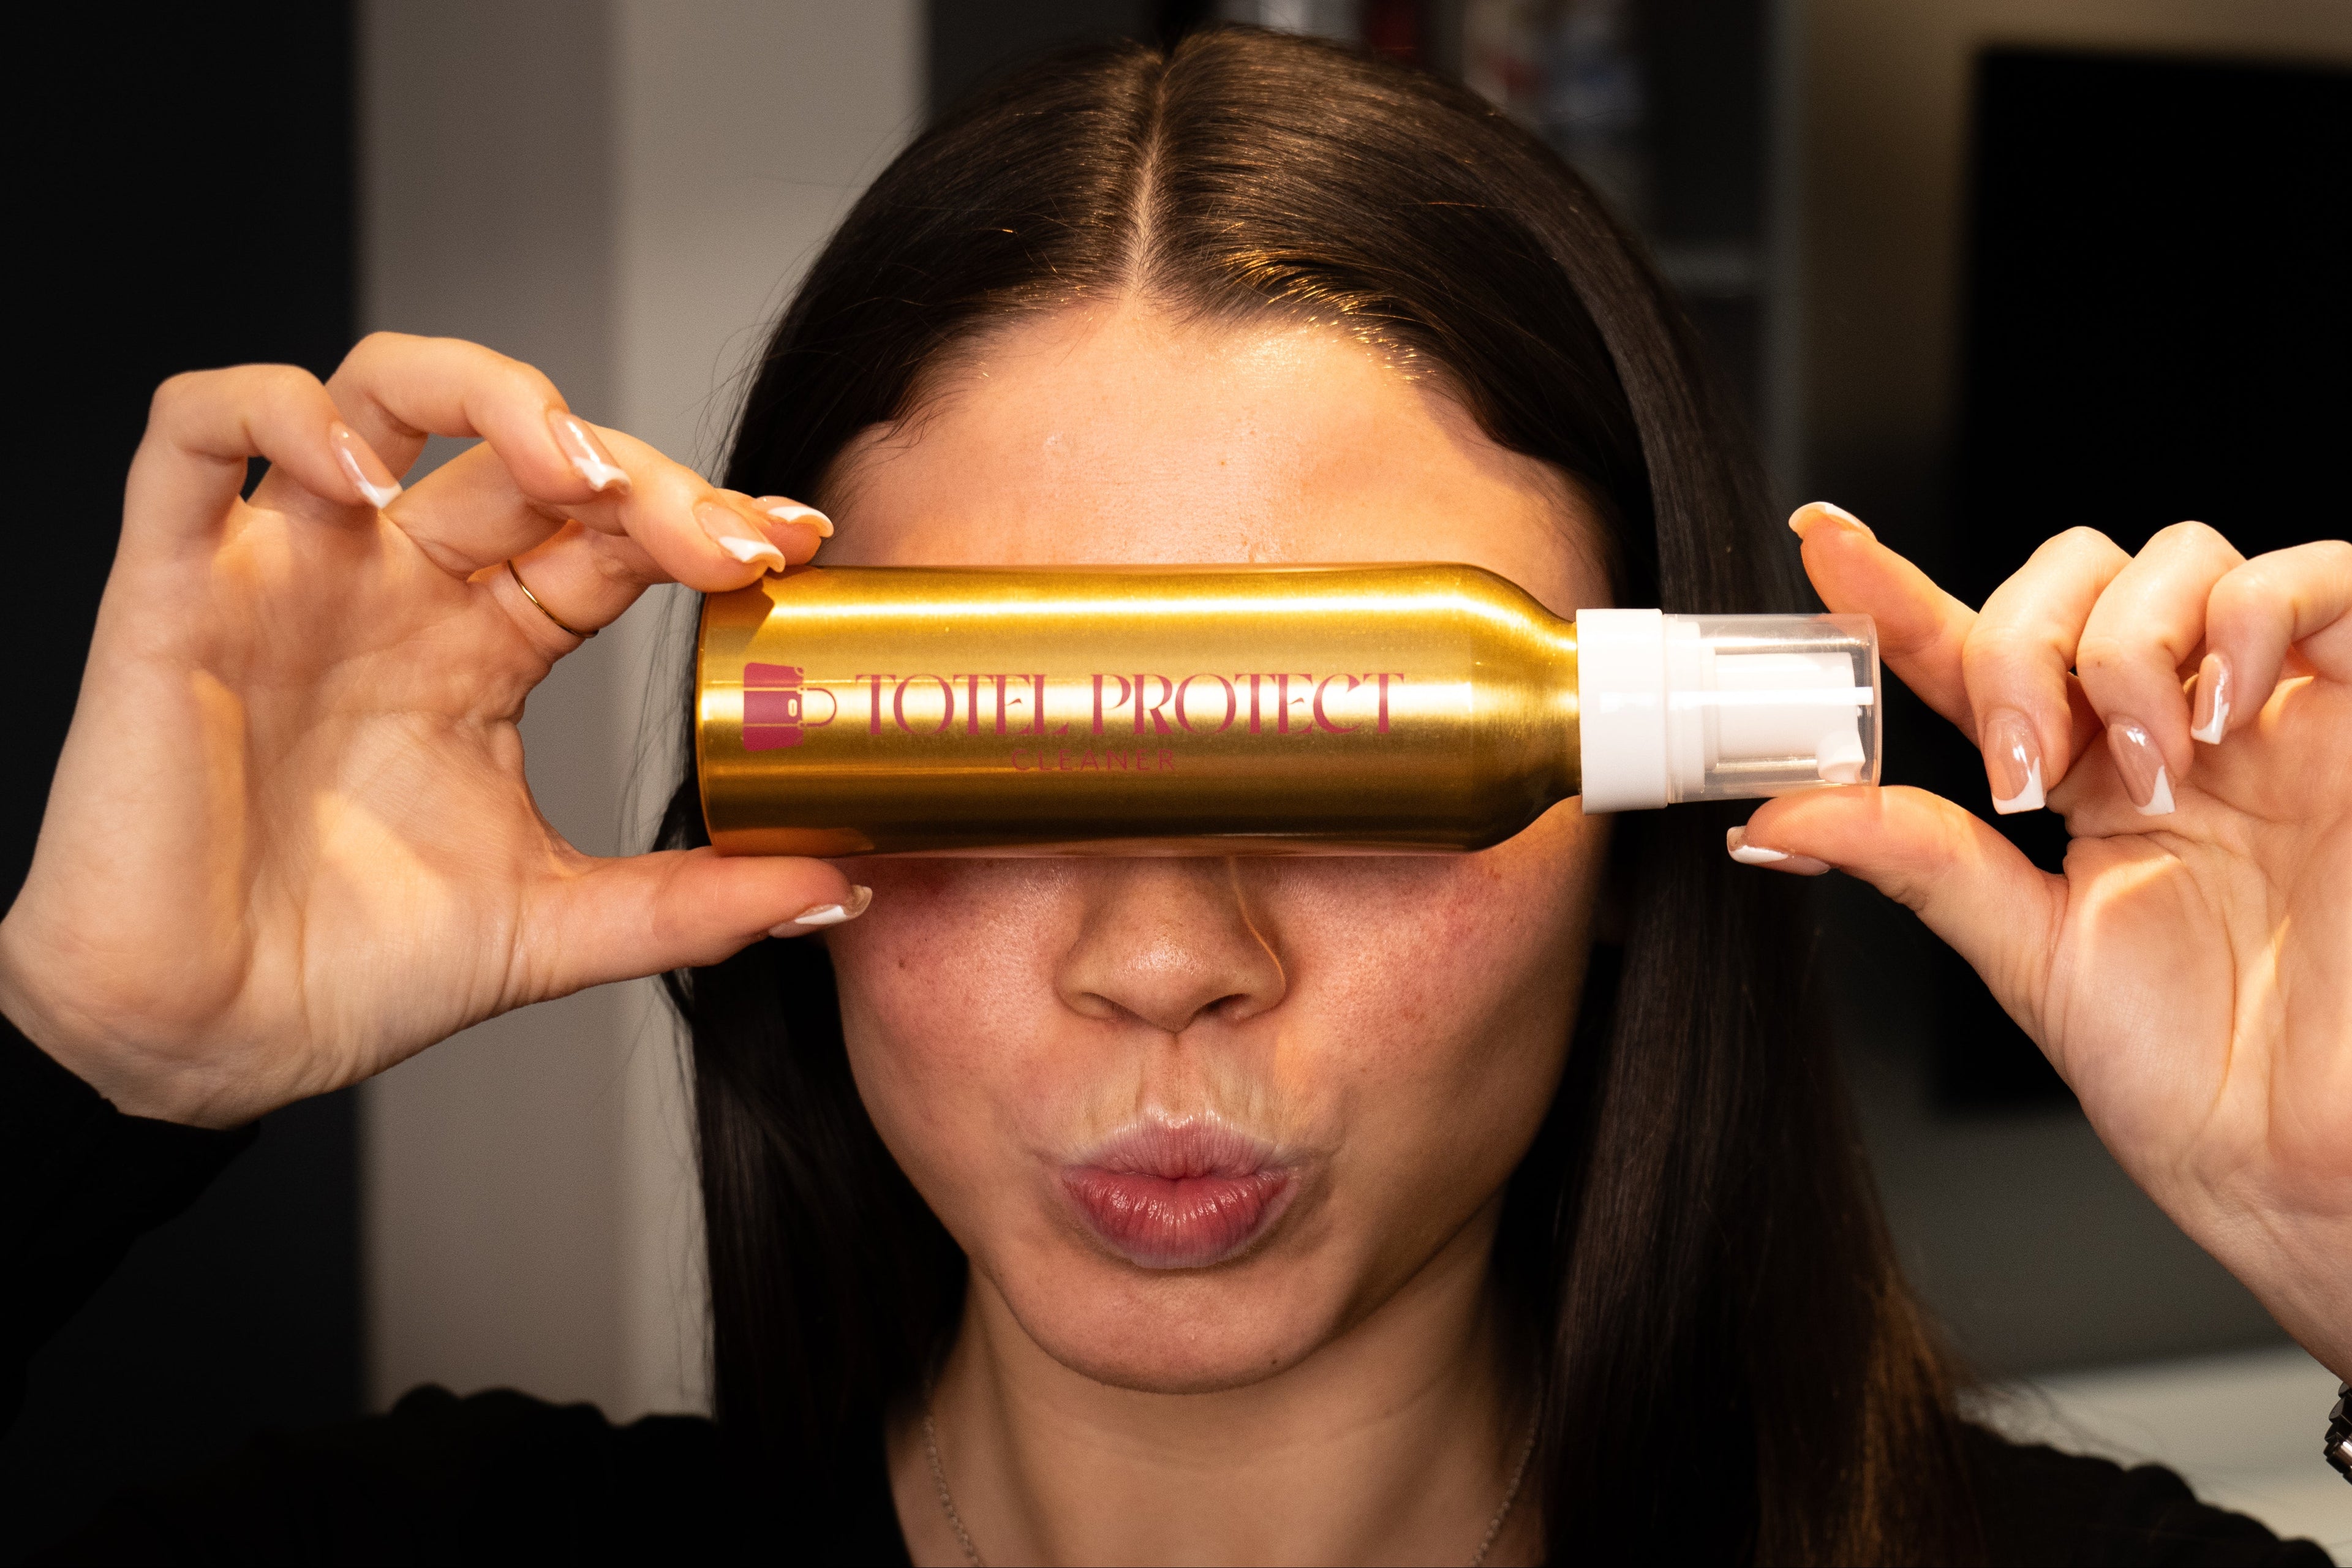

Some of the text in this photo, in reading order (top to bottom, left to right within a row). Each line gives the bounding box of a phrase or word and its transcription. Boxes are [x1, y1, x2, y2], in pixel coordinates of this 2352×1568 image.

[855, 673, 1404, 736] TOTEL PROTECT
[1011, 749, 1175, 771] CLEANER
